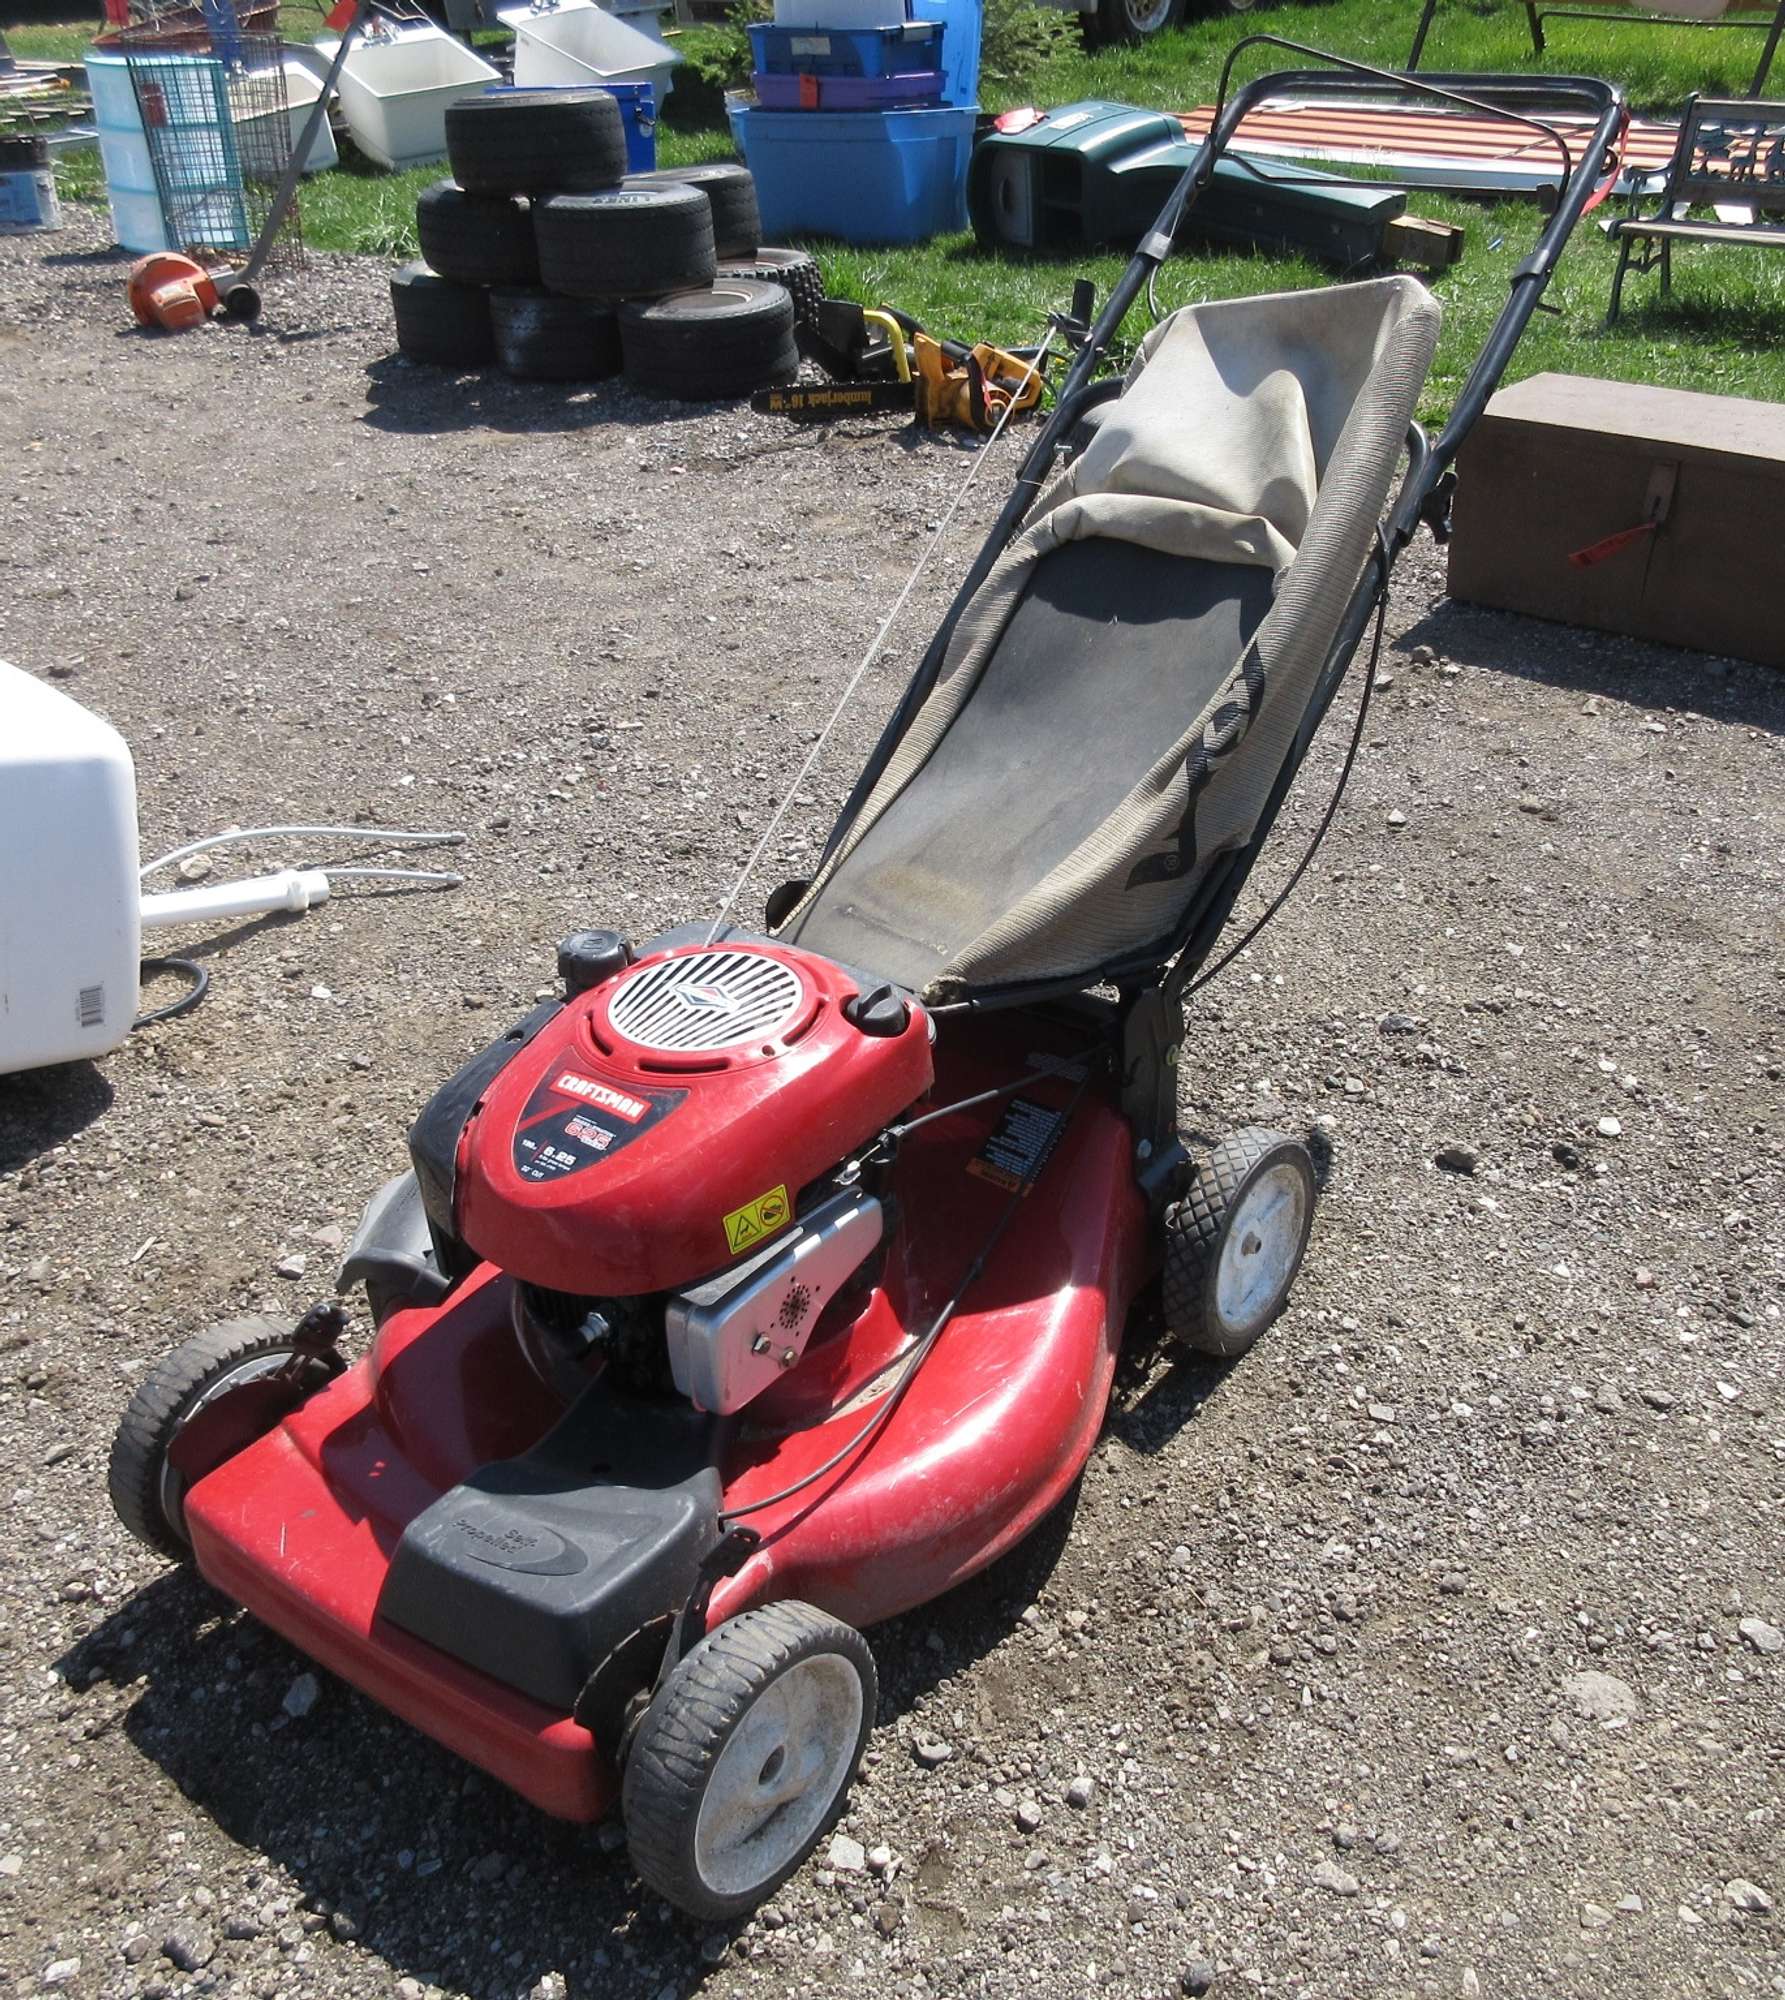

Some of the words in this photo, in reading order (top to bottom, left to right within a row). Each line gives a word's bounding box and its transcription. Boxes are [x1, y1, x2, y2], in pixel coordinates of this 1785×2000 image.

[557, 1074, 645, 1117] CRAFTSMAN
[564, 1121, 613, 1148] 625
[543, 1146, 577, 1165] 6.25
